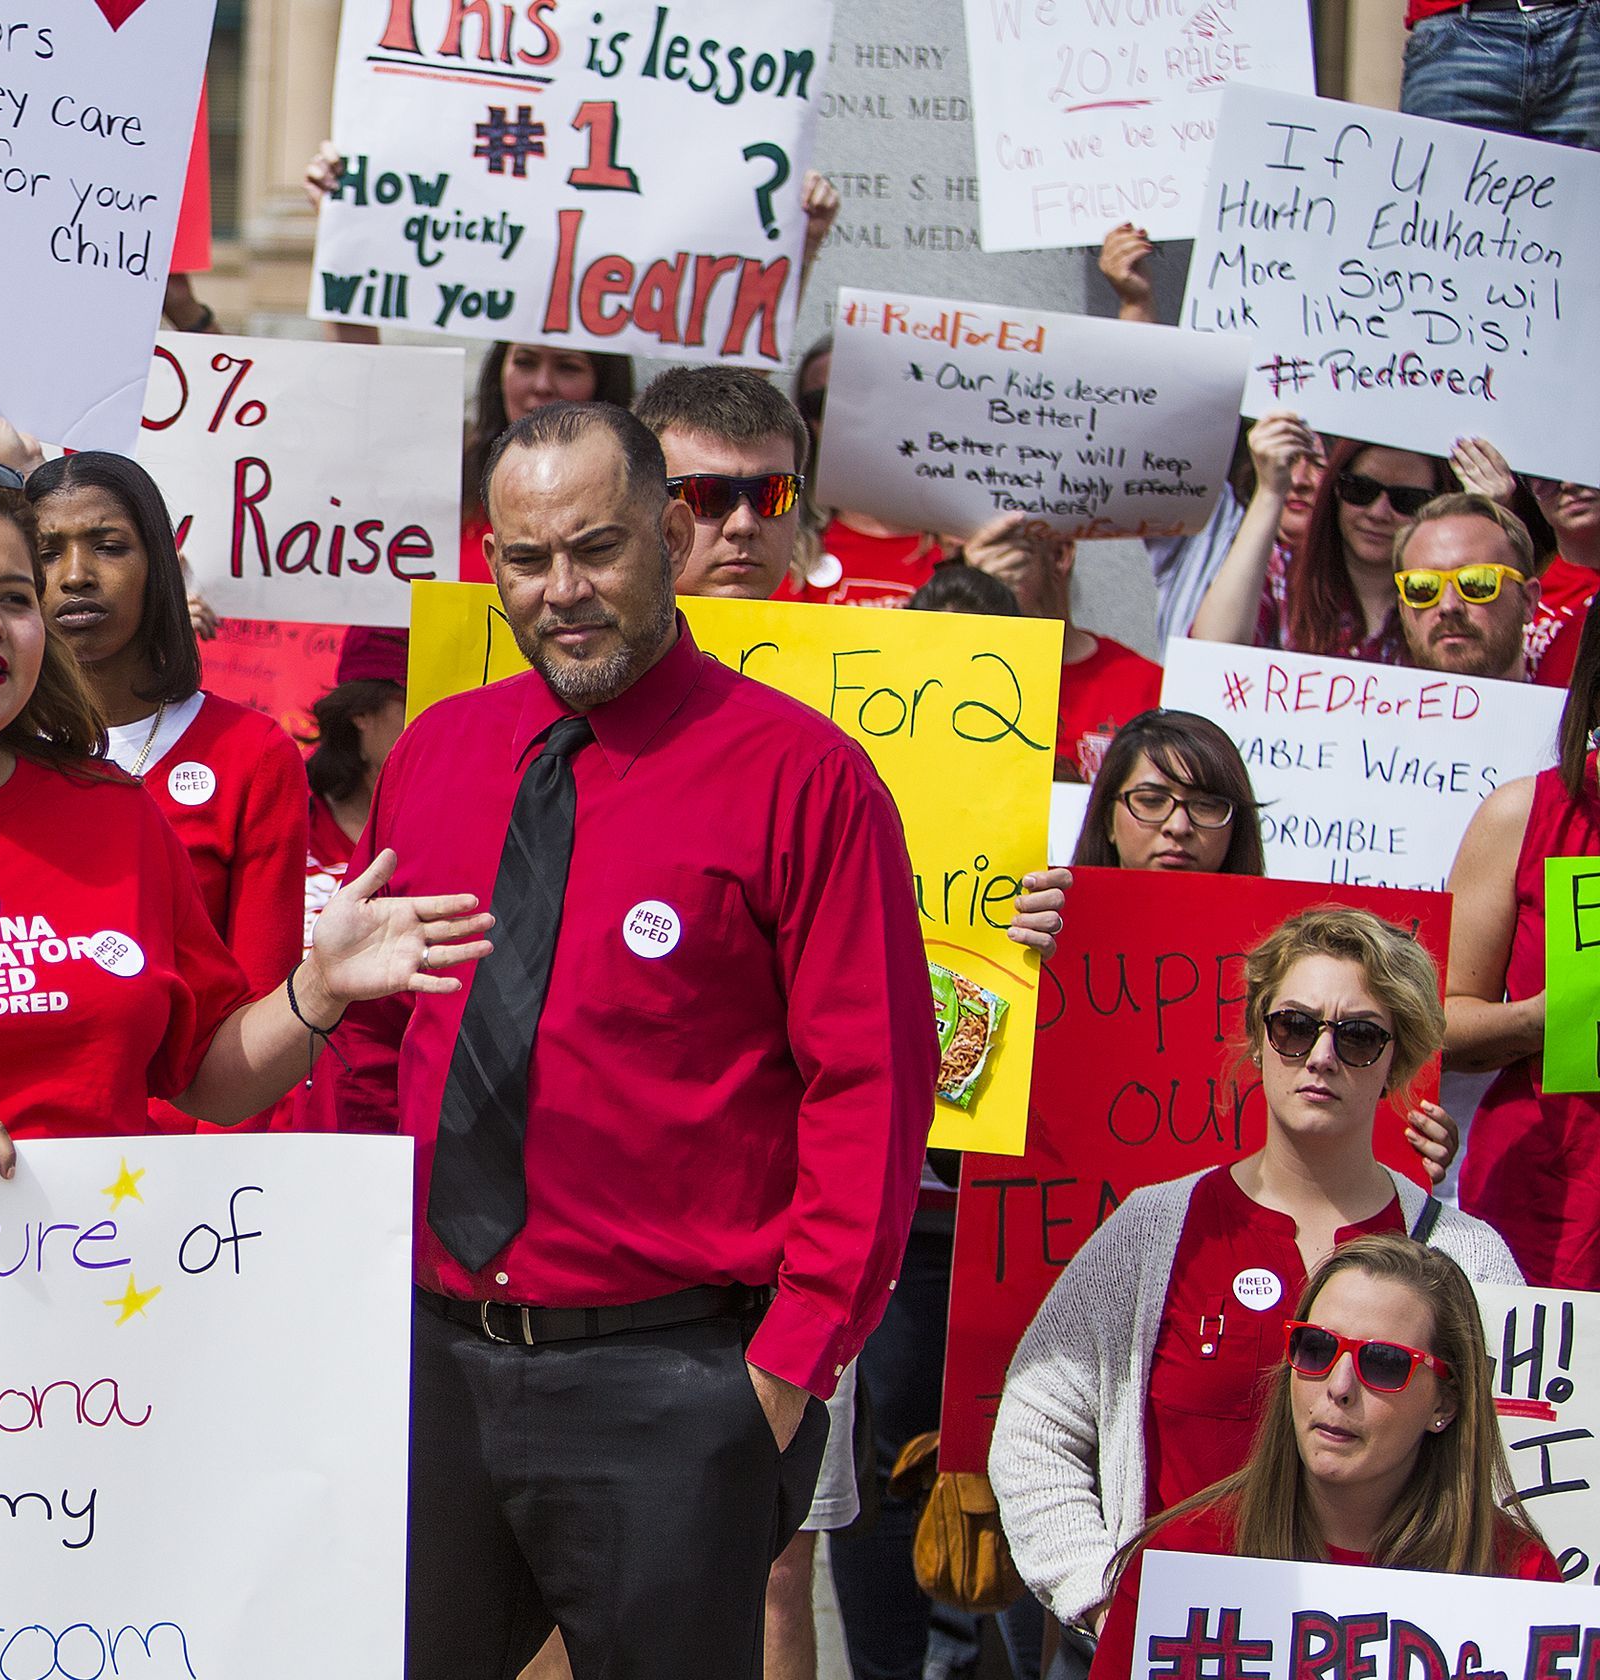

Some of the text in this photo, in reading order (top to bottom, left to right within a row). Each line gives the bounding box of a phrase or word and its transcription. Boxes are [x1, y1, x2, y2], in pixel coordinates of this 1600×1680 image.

[586, 13, 632, 76] is
[640, 7, 815, 105] lesson
[853, 45, 949, 70] HENRY
[1048, 42, 1252, 102] 20% RAISE
[51, 96, 146, 147] care
[818, 92, 974, 121] ONAL MED
[1064, 135, 1103, 159] we
[1122, 120, 1156, 147] be
[1266, 122, 1372, 178] If
[1391, 138, 1433, 196] U
[70, 177, 157, 227] your
[333, 157, 449, 206] How
[1032, 173, 1181, 237] FRIENDS
[1217, 180, 1563, 268] Hurtn Edukation
[404, 212, 526, 266] quickly
[434, 284, 514, 327] you
[542, 209, 791, 361] learn
[1208, 244, 1560, 319] More Signs wil
[842, 302, 1046, 354] #RedForEd
[1191, 294, 1532, 356] Luk like Dis!
[934, 362, 996, 393] Our
[1064, 378, 1157, 405] deserve
[987, 399, 1097, 442] Better!
[928, 431, 1008, 458] Better
[915, 462, 956, 480] and
[965, 465, 1045, 489] attract
[1059, 472, 1113, 504] highly
[989, 489, 1100, 519] Teachers!
[231, 457, 436, 581] Raise
[1223, 664, 1480, 720] #REDforED
[175, 770, 207, 780] #RED
[175, 781, 209, 791] forED
[1238, 737, 1497, 801] ABLE WAGES
[1261, 813, 1408, 856] ORDABLE
[629, 920, 669, 944] forED
[635, 909, 673, 931] #RED
[94, 936, 117, 958] #RED
[102, 944, 129, 968] forED
[179, 1186, 263, 1274] of
[1238, 1286, 1273, 1295] forED
[1239, 1277, 1271, 1285] #RED
